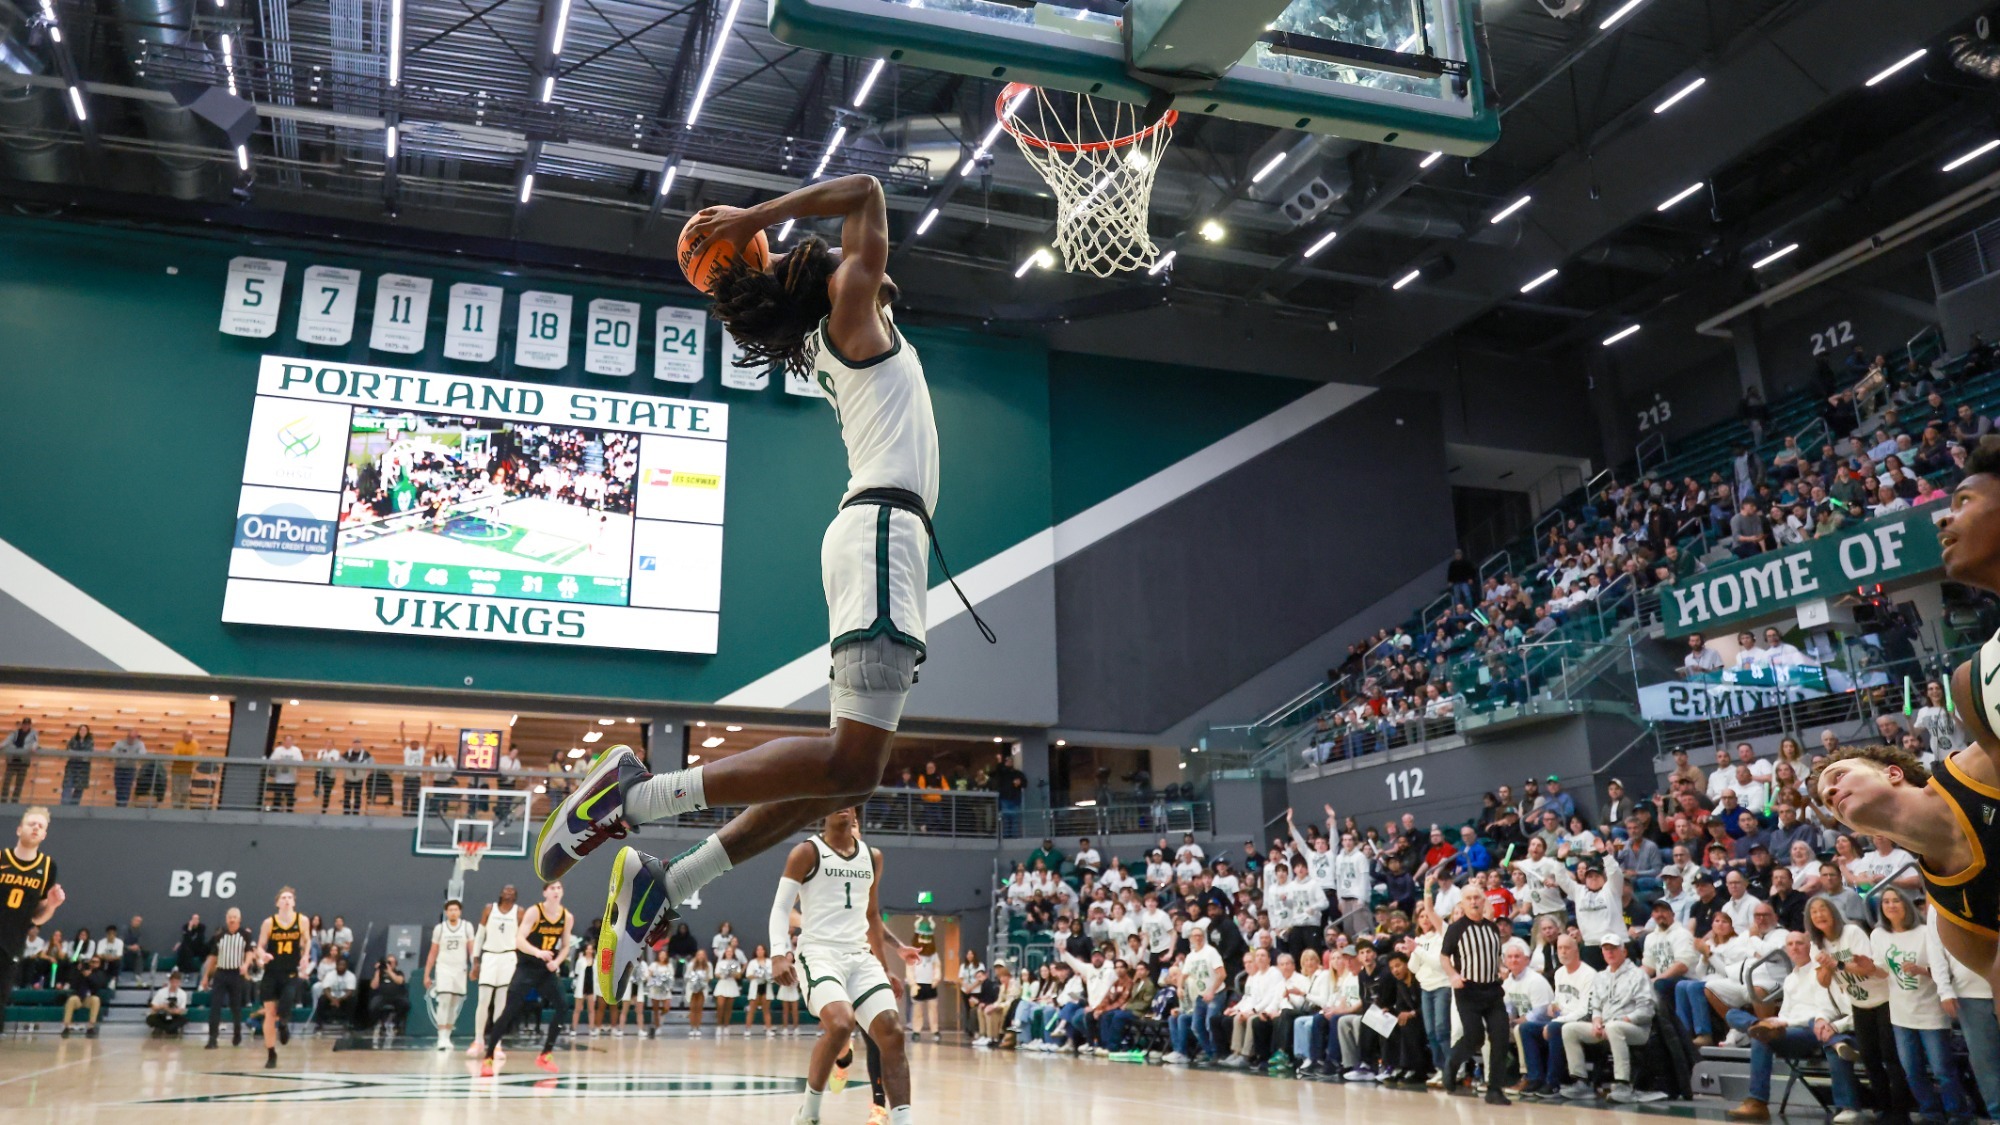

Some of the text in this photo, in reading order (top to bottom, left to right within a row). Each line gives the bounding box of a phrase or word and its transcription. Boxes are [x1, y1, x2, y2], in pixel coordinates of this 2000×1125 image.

[242, 278, 265, 307] 5
[321, 287, 340, 315] 7
[389, 295, 412, 324] 11
[462, 303, 484, 332] 11
[529, 311, 559, 340] 18
[594, 318, 631, 348] 20
[1810, 320, 1854, 356] 212
[663, 326, 697, 355] 24
[279, 363, 710, 433] PORTLAND STATE
[1637, 401, 1671, 431] 213
[243, 516, 328, 544] OnPoint
[241, 539, 326, 553] COMMUNITY CREDIT UNION
[522, 576, 543, 592] 31
[1673, 522, 1906, 627] HOME OF
[374, 596, 585, 639] VIKINGS
[465, 745, 493, 769] 28
[1385, 767, 1425, 801] 112
[0, 873, 41, 889] IDAHO
[169, 870, 237, 899] B16
[825, 868, 871, 879] VIKINGS
[7, 888, 24, 909] 0
[844, 882, 852, 909] 1
[498, 923, 505, 933] 4
[277, 941, 294, 955] 14
